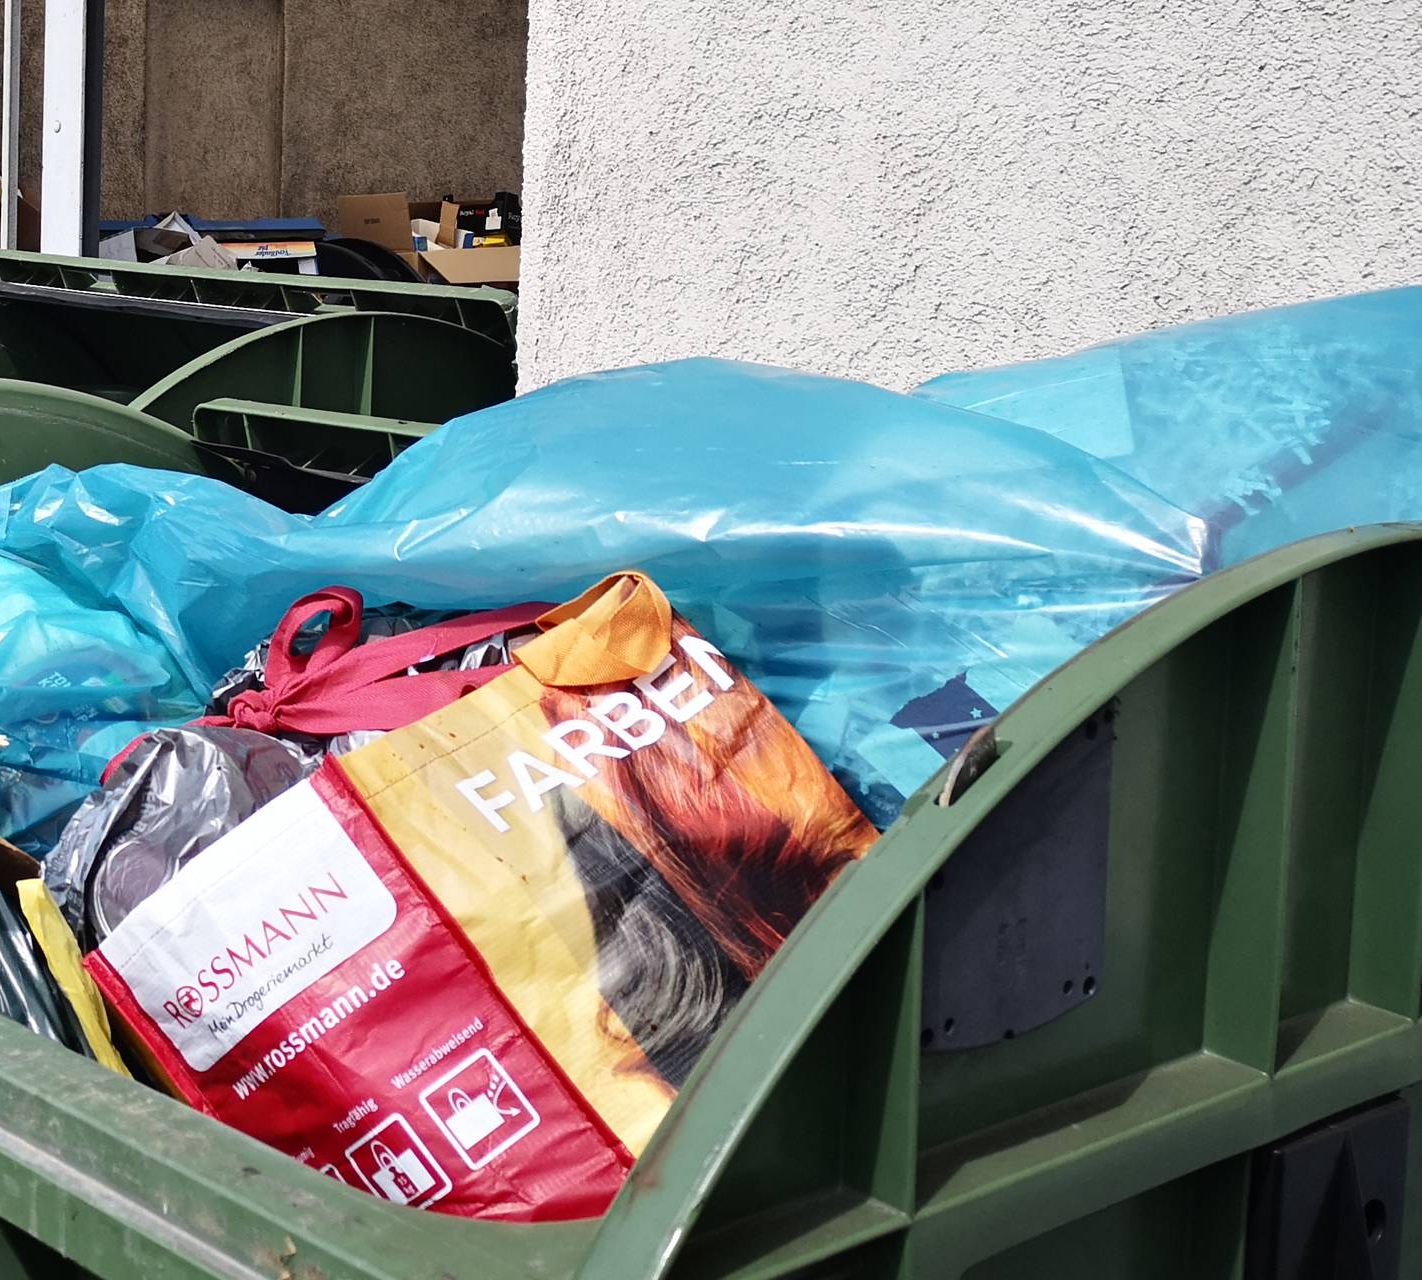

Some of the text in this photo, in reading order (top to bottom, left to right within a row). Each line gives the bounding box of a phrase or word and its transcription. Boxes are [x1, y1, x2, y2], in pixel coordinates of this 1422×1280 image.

[163, 872, 348, 1029] ROSSMANN
[208, 933, 334, 1040] Mein Drogeriemarkt
[232, 958, 406, 1100] www.rossmann.de
[390, 1016, 484, 1090] Wasserabweisend
[333, 1098, 378, 1134] Tragfähig
